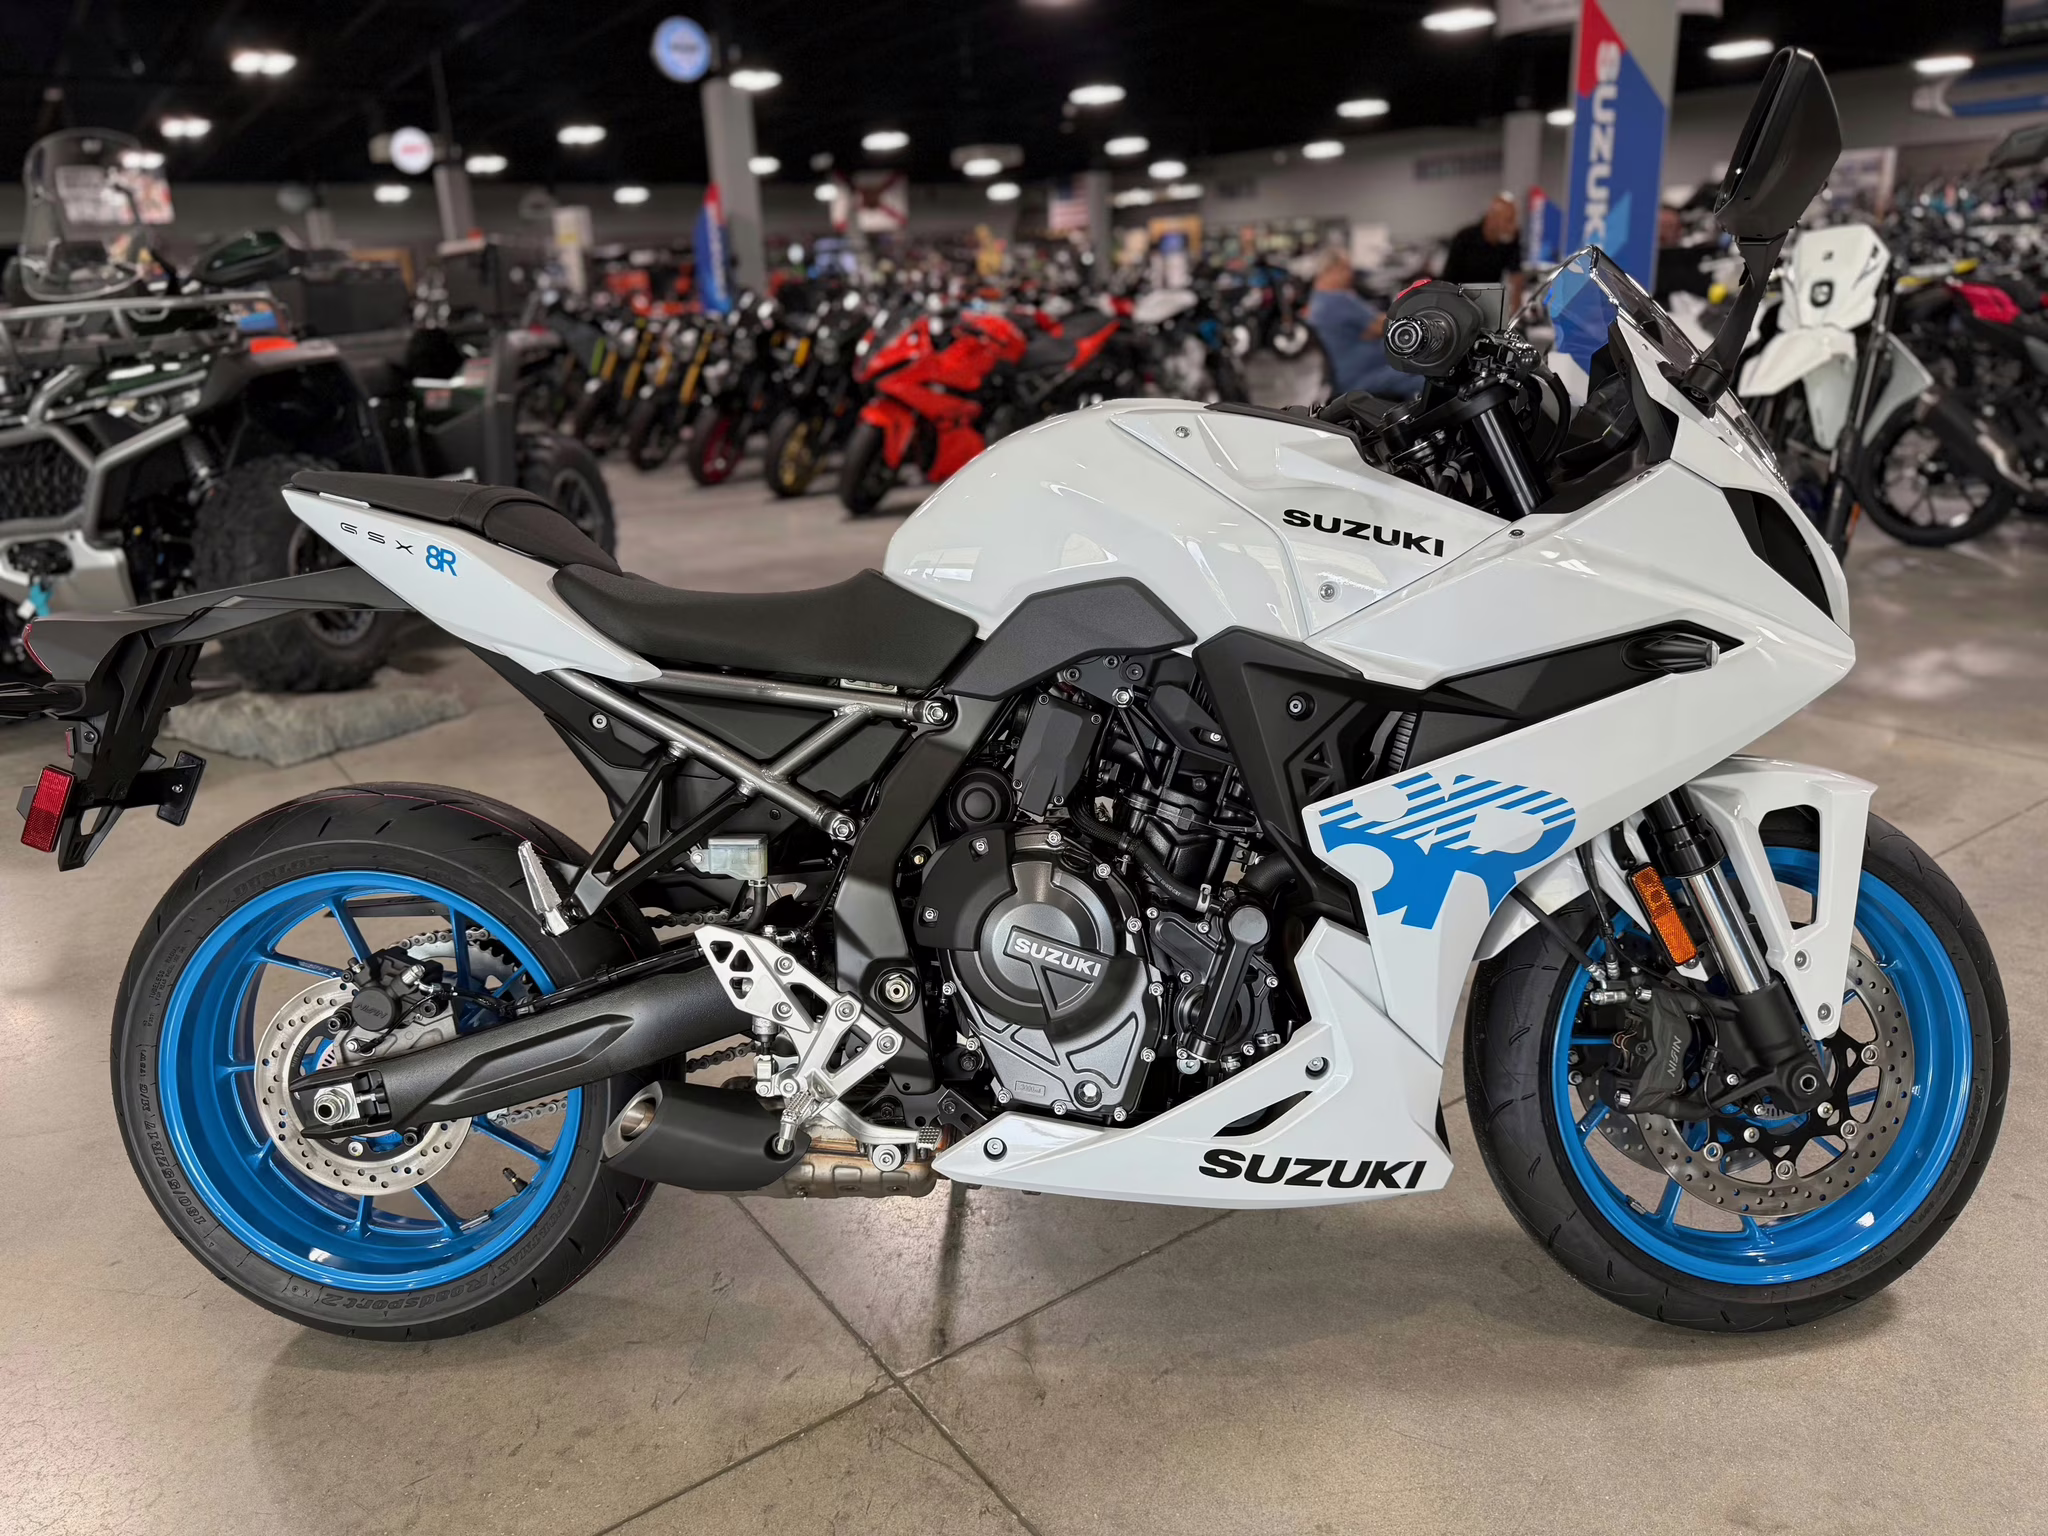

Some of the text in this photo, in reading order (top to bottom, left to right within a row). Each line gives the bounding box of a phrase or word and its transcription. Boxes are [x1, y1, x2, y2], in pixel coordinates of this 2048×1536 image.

[1583, 39, 1621, 249] SUZUK
[1283, 509, 1444, 557] SUZUKI
[426, 545, 457, 576] 8R
[1014, 937, 1102, 977] SUZUKI
[1667, 1035, 1682, 1078] NISSIN
[144, 1120, 207, 1226] 180/55ZR17
[1198, 1149, 1428, 1189] SUZUKI
[496, 1190, 571, 1276] SPORTMAX
